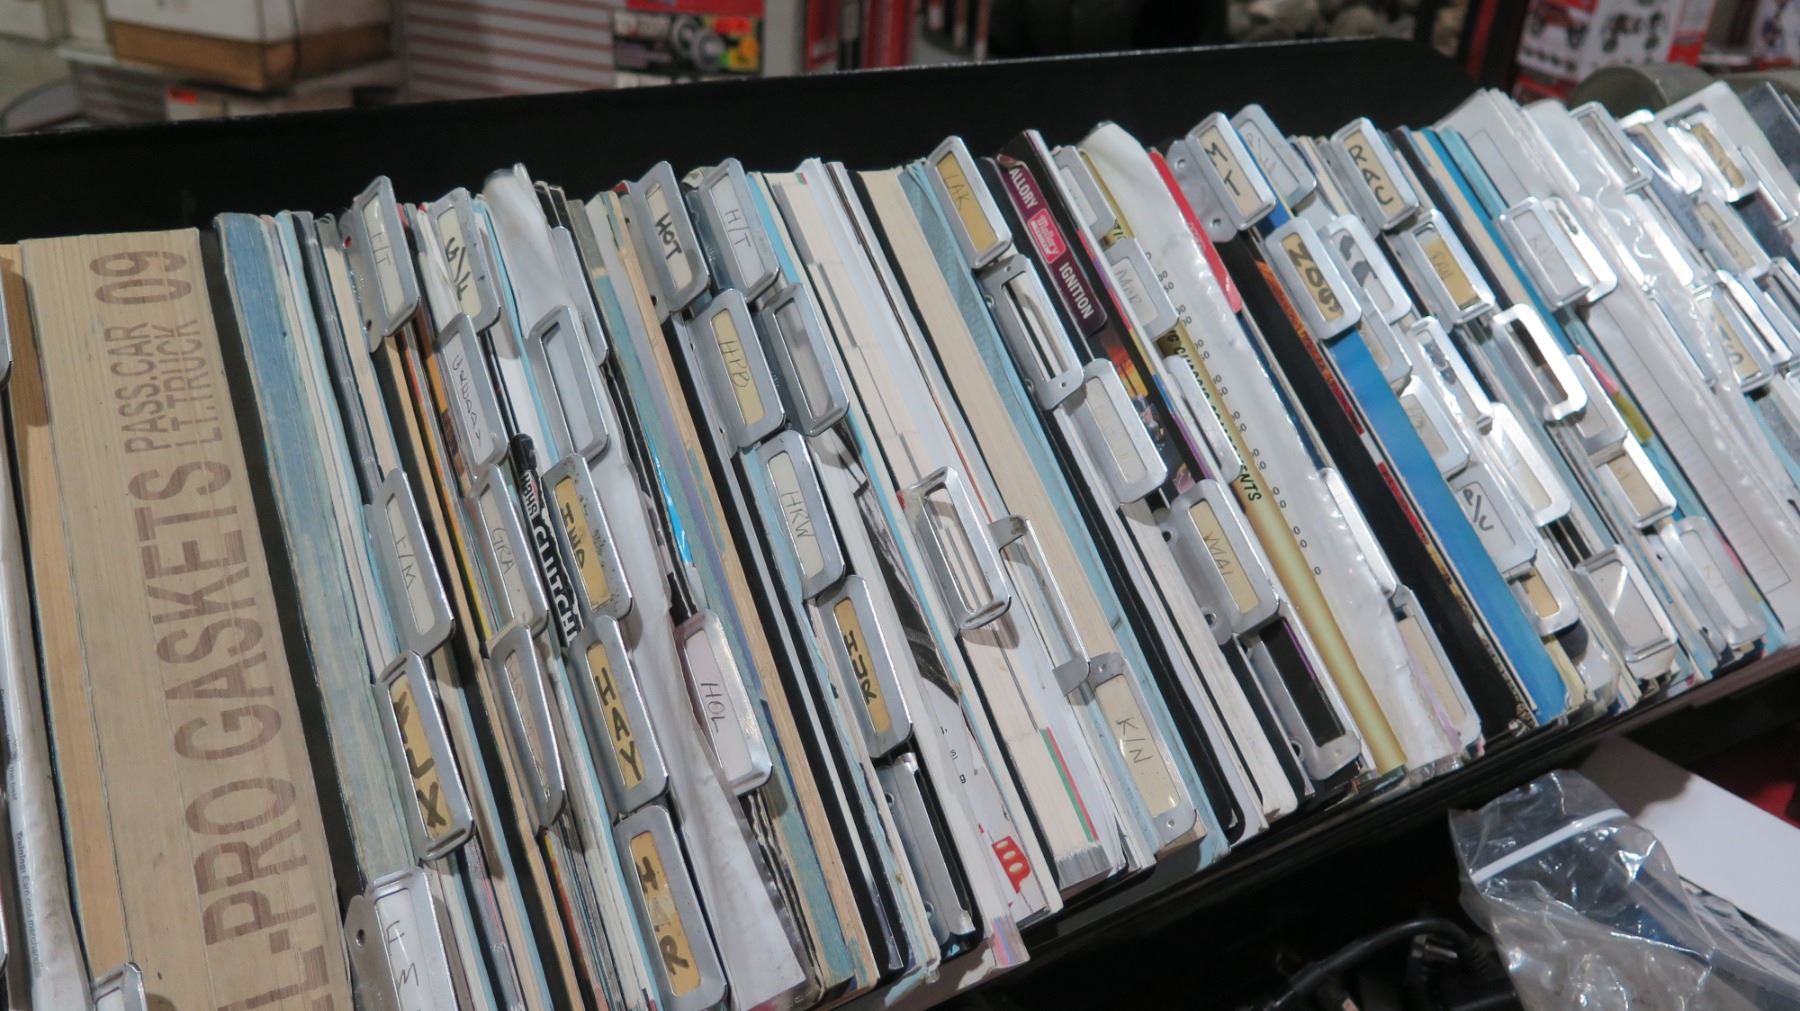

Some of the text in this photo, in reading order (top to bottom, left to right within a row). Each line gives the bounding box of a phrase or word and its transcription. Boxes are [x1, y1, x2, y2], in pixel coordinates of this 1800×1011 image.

[1352, 144, 1394, 206] RAC
[654, 211, 683, 261] HOT
[724, 207, 751, 248] H/T
[89, 250, 193, 305] 09
[1058, 262, 1095, 320] IGNITION
[780, 489, 814, 539] HKW
[1462, 487, 1494, 533] P/C
[491, 527, 516, 575] GRA
[127, 460, 282, 760] GASKETS
[594, 667, 643, 781] HAY
[700, 682, 727, 733] HOL
[185, 777, 335, 1011] L-PRO
